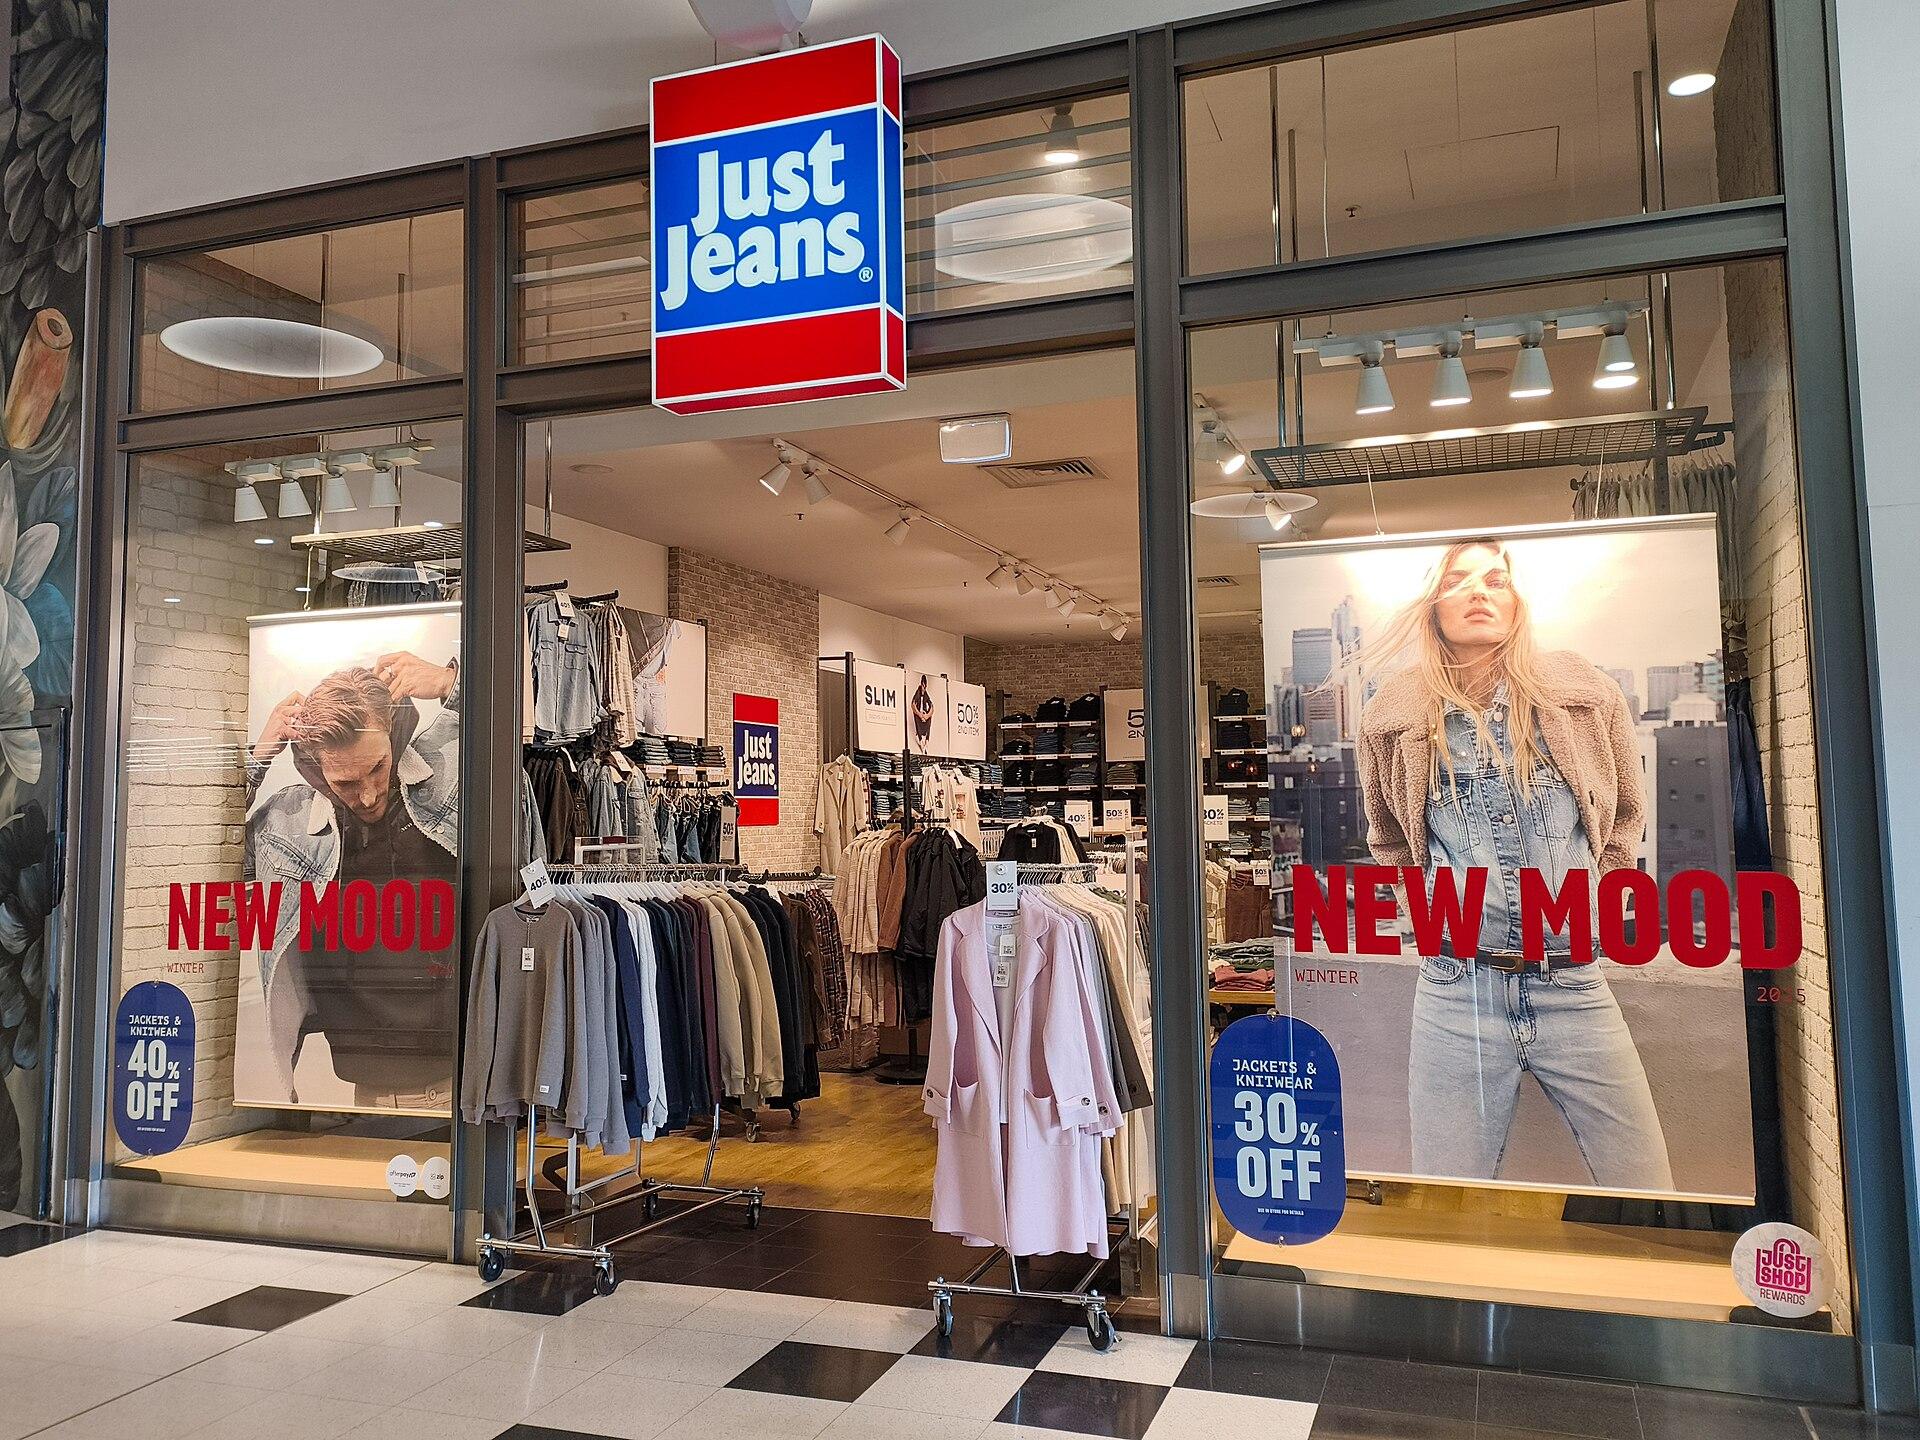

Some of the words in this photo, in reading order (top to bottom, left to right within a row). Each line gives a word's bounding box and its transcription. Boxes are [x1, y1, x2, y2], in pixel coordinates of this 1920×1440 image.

[690, 129, 845, 237] Just
[865, 685, 896, 708] SLIM
[958, 703, 979, 724] 50%
[743, 729, 772, 762] Just
[737, 756, 776, 790] Jeans
[530, 875, 547, 892] 40%
[991, 882, 1014, 894] 30%
[168, 881, 283, 951] NEW
[299, 879, 456, 954] MOOD
[1292, 864, 1489, 958] NEW
[1519, 867, 1803, 970] MOOD
[166, 963, 205, 974] WINTER
[1294, 968, 1359, 984] WINTER
[129, 1015, 169, 1025] JACKETS
[174, 1016, 182, 1025] &
[130, 1026, 178, 1037] KNITWEAR
[127, 1039, 180, 1080] 40%
[1233, 1059, 1297, 1074] JACKETS
[1306, 1062, 1317, 1075] &
[1236, 1074, 1313, 1090] KNITWEAR
[126, 1081, 180, 1121] OFF
[1234, 1090, 1320, 1146] 30%
[1236, 1146, 1321, 1201] OFF
[1761, 1250, 1806, 1272] JUST
[1760, 1266, 1806, 1288] SHOP
[1760, 1288, 1806, 1306] REWARDS
